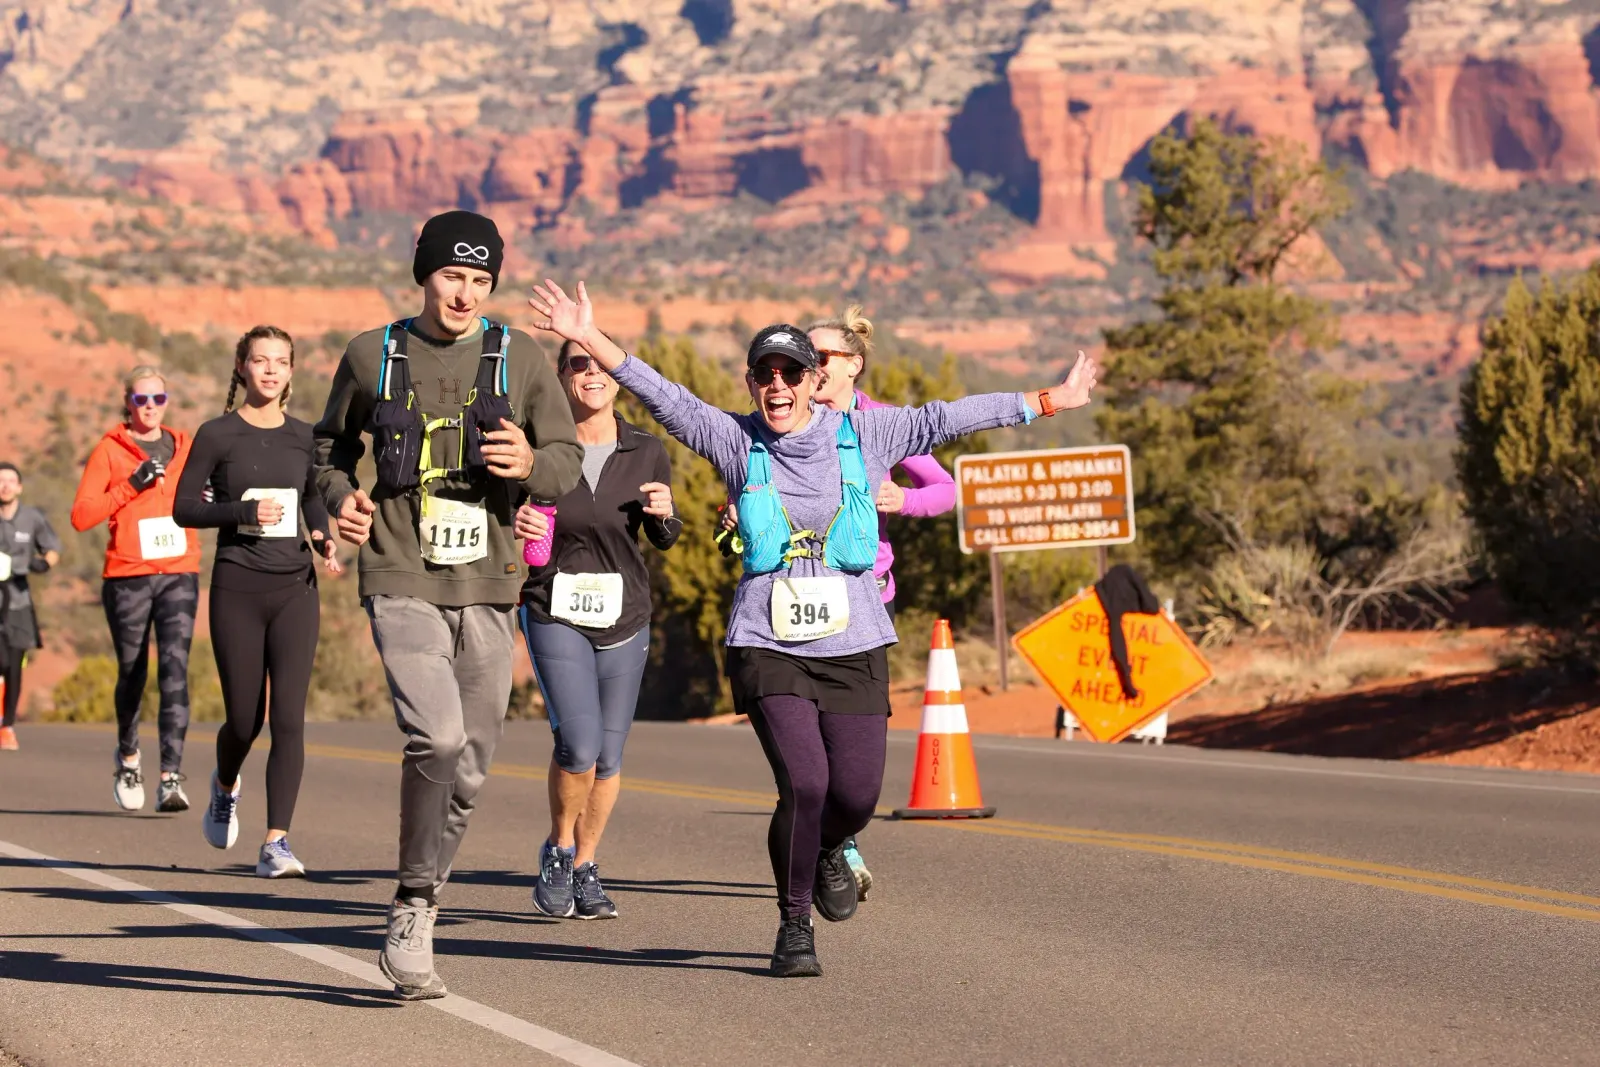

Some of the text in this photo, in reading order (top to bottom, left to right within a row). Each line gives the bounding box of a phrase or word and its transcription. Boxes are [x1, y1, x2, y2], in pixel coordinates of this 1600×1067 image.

[962, 463, 1028, 484] PALATKI
[1031, 462, 1047, 481] &
[975, 485, 1023, 504] HOURS
[1059, 481, 1078, 499] TO
[987, 502, 1102, 525] TO VISIT PALATKI
[154, 534, 175, 547] 481
[429, 524, 480, 548] 1115
[974, 527, 1010, 545] CALL
[790, 603, 830, 625] 394
[1070, 611, 1163, 645] SPEIAL
